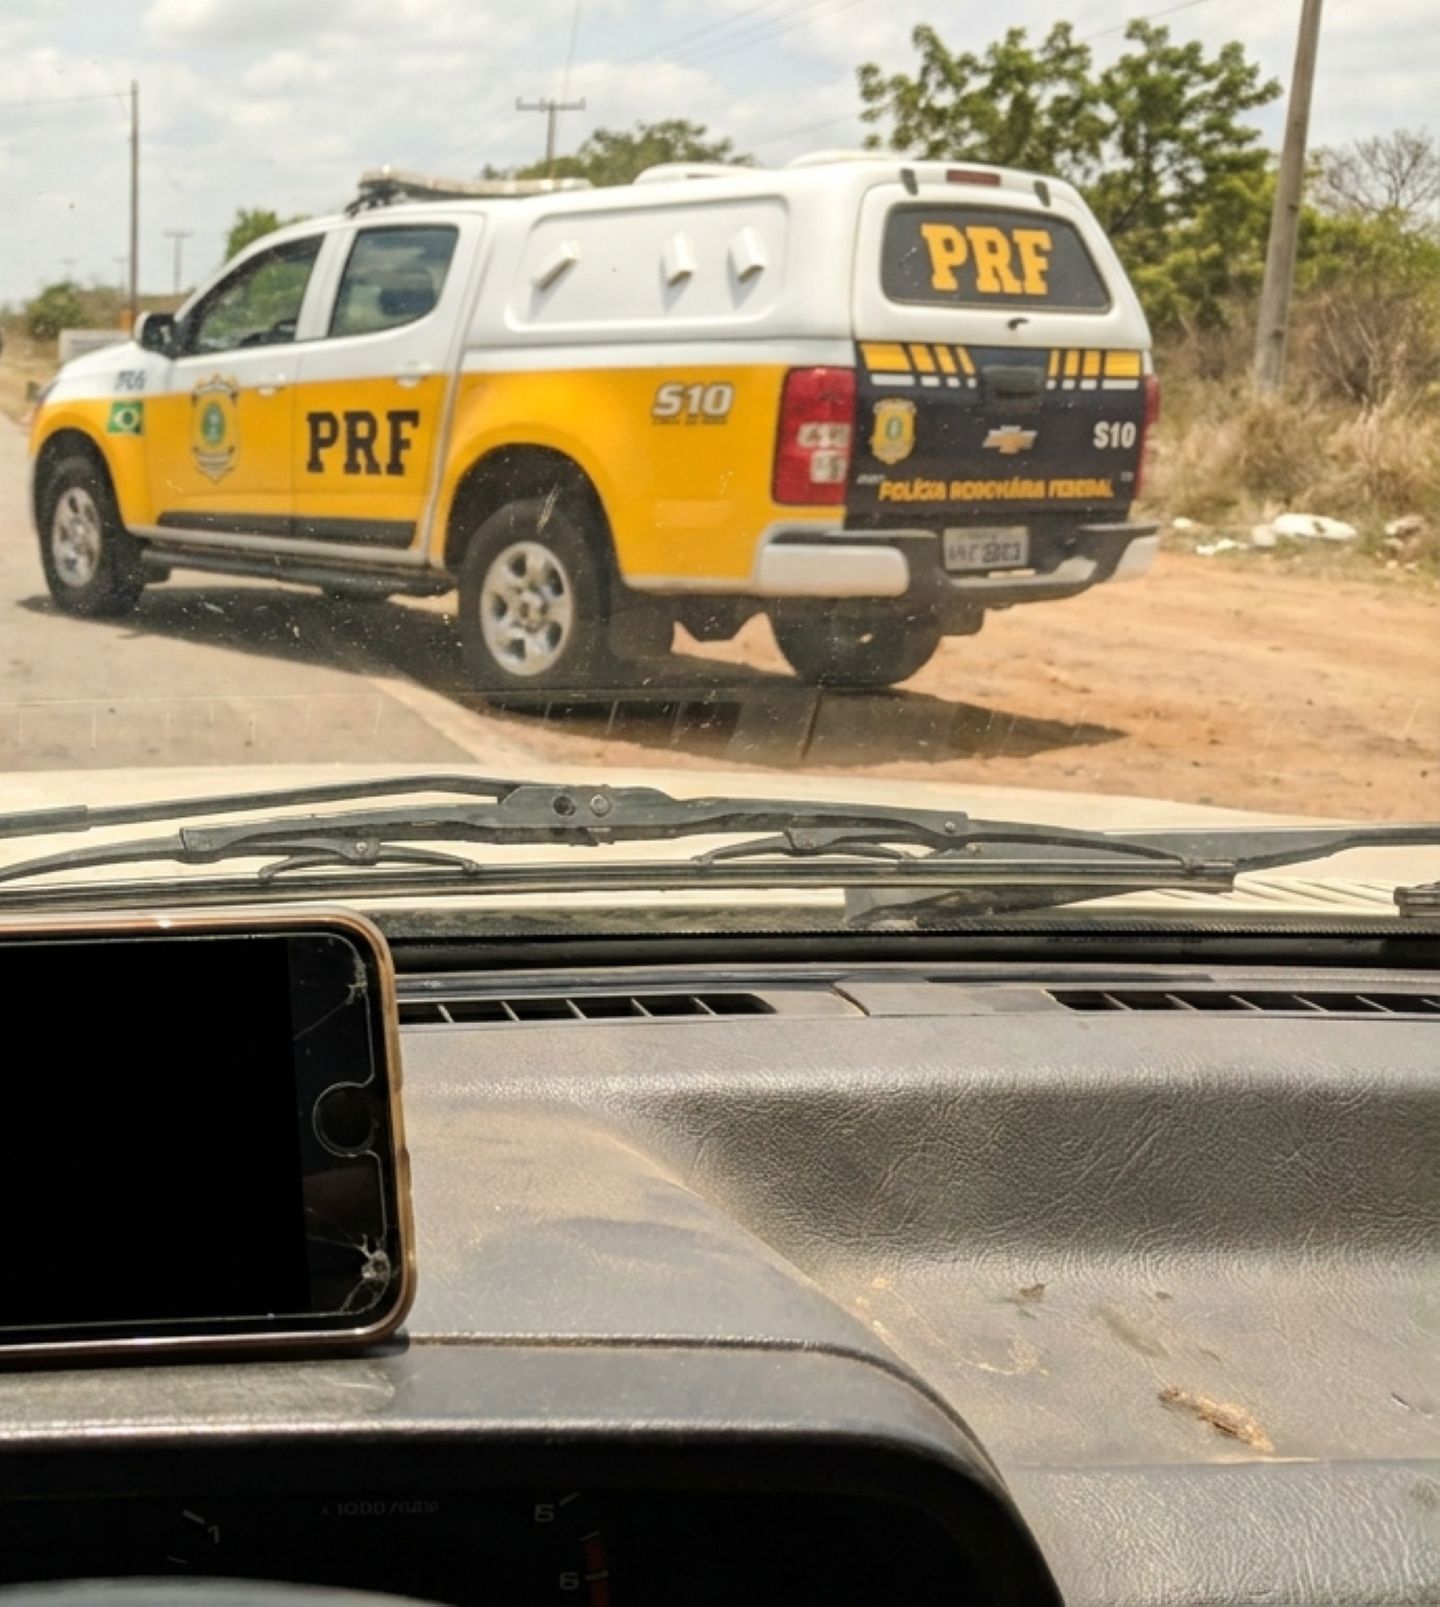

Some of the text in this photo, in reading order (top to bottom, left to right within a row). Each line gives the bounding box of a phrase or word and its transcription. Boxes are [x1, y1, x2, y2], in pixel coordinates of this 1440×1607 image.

[921, 223, 1052, 295] PRF
[651, 382, 733, 418] S10
[307, 410, 419, 475] PRF
[1093, 420, 1136, 449] S10
[559, 1571, 580, 1590] 6
